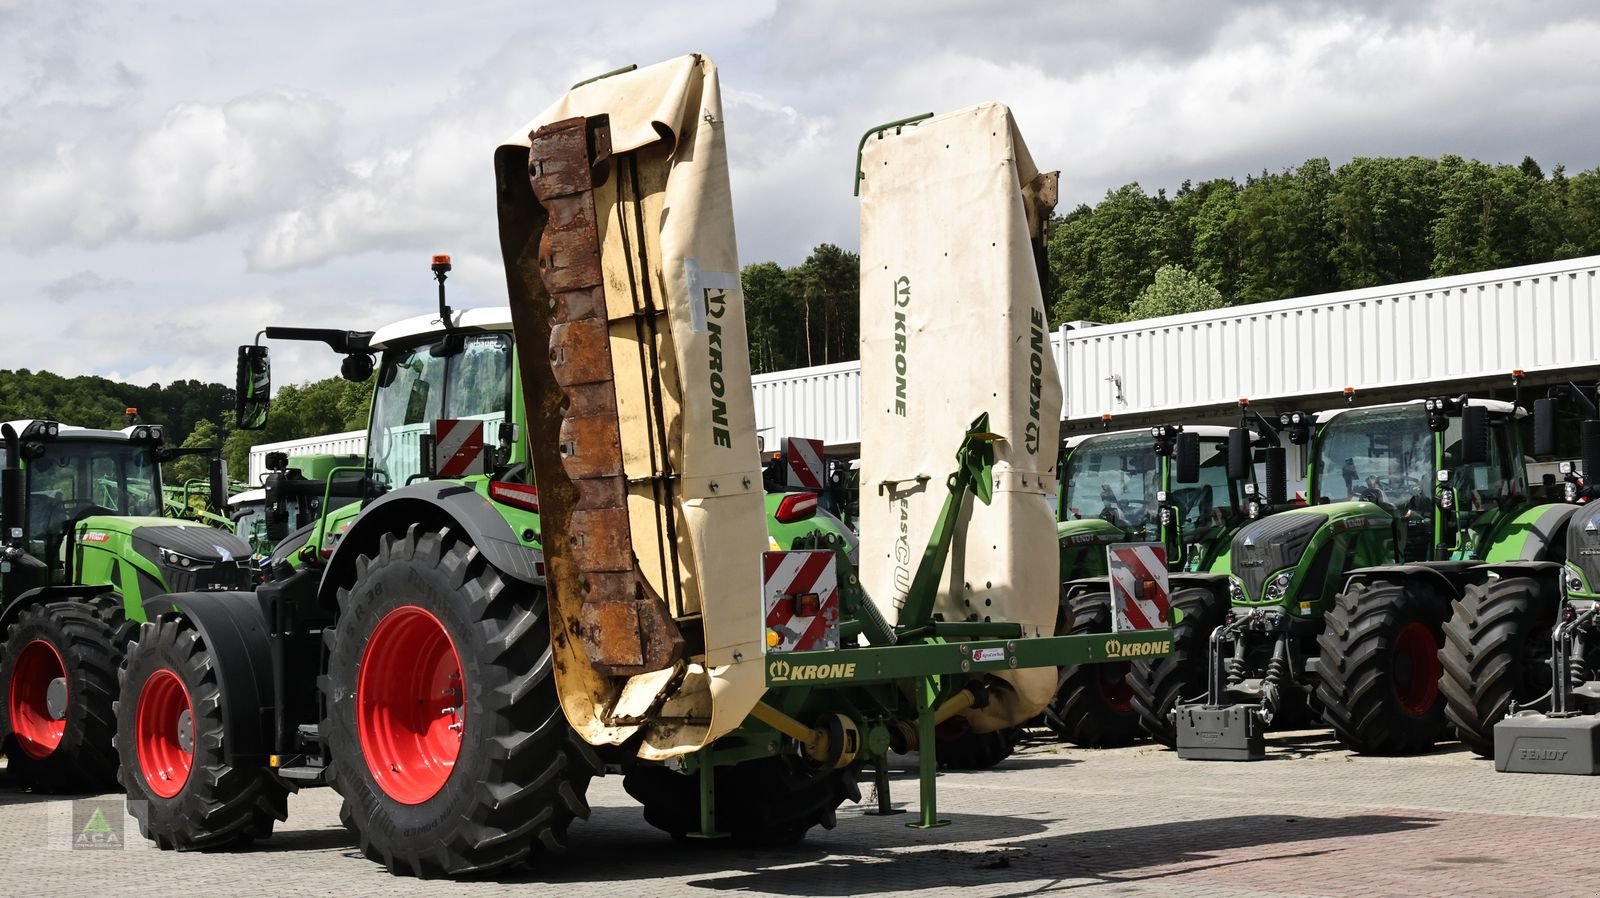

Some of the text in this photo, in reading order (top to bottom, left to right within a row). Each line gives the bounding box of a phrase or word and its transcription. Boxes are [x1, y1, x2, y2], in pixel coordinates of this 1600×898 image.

[707, 322, 731, 448] KRONE
[894, 311, 907, 417] KRONE
[1030, 307, 1043, 421] KRONE
[790, 663, 856, 680] KRONE
[1121, 641, 1170, 656] KRONE
[1519, 749, 1568, 760] FENDT
